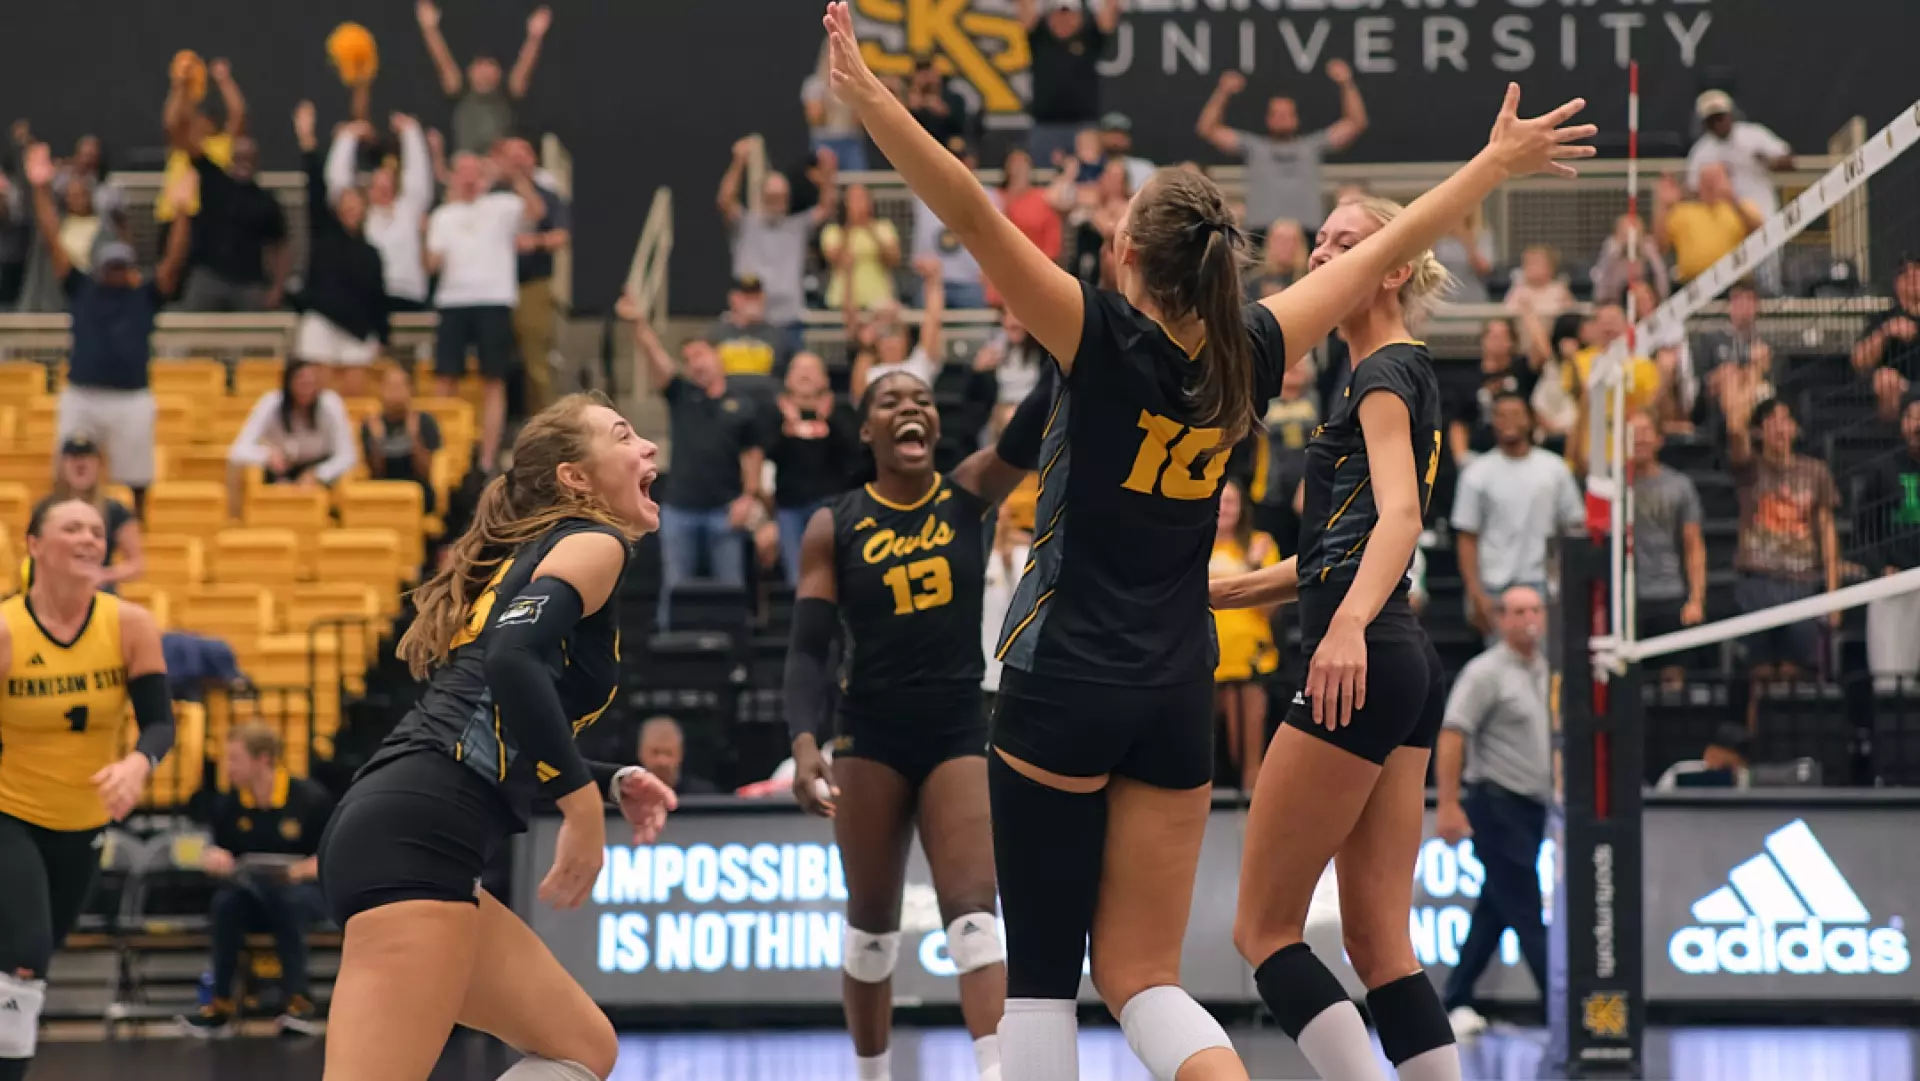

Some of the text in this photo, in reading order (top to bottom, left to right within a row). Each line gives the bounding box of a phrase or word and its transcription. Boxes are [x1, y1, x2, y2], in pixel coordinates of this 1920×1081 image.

[1120, 408, 1232, 500] 10
[862, 513, 956, 564] Owls
[882, 555, 954, 615] 13
[64, 705, 89, 732] 1
[592, 843, 848, 904] IMPOSSIBL
[598, 911, 650, 973] IS
[655, 910, 845, 973] NOTHIN
[1667, 914, 1911, 974] adidas
